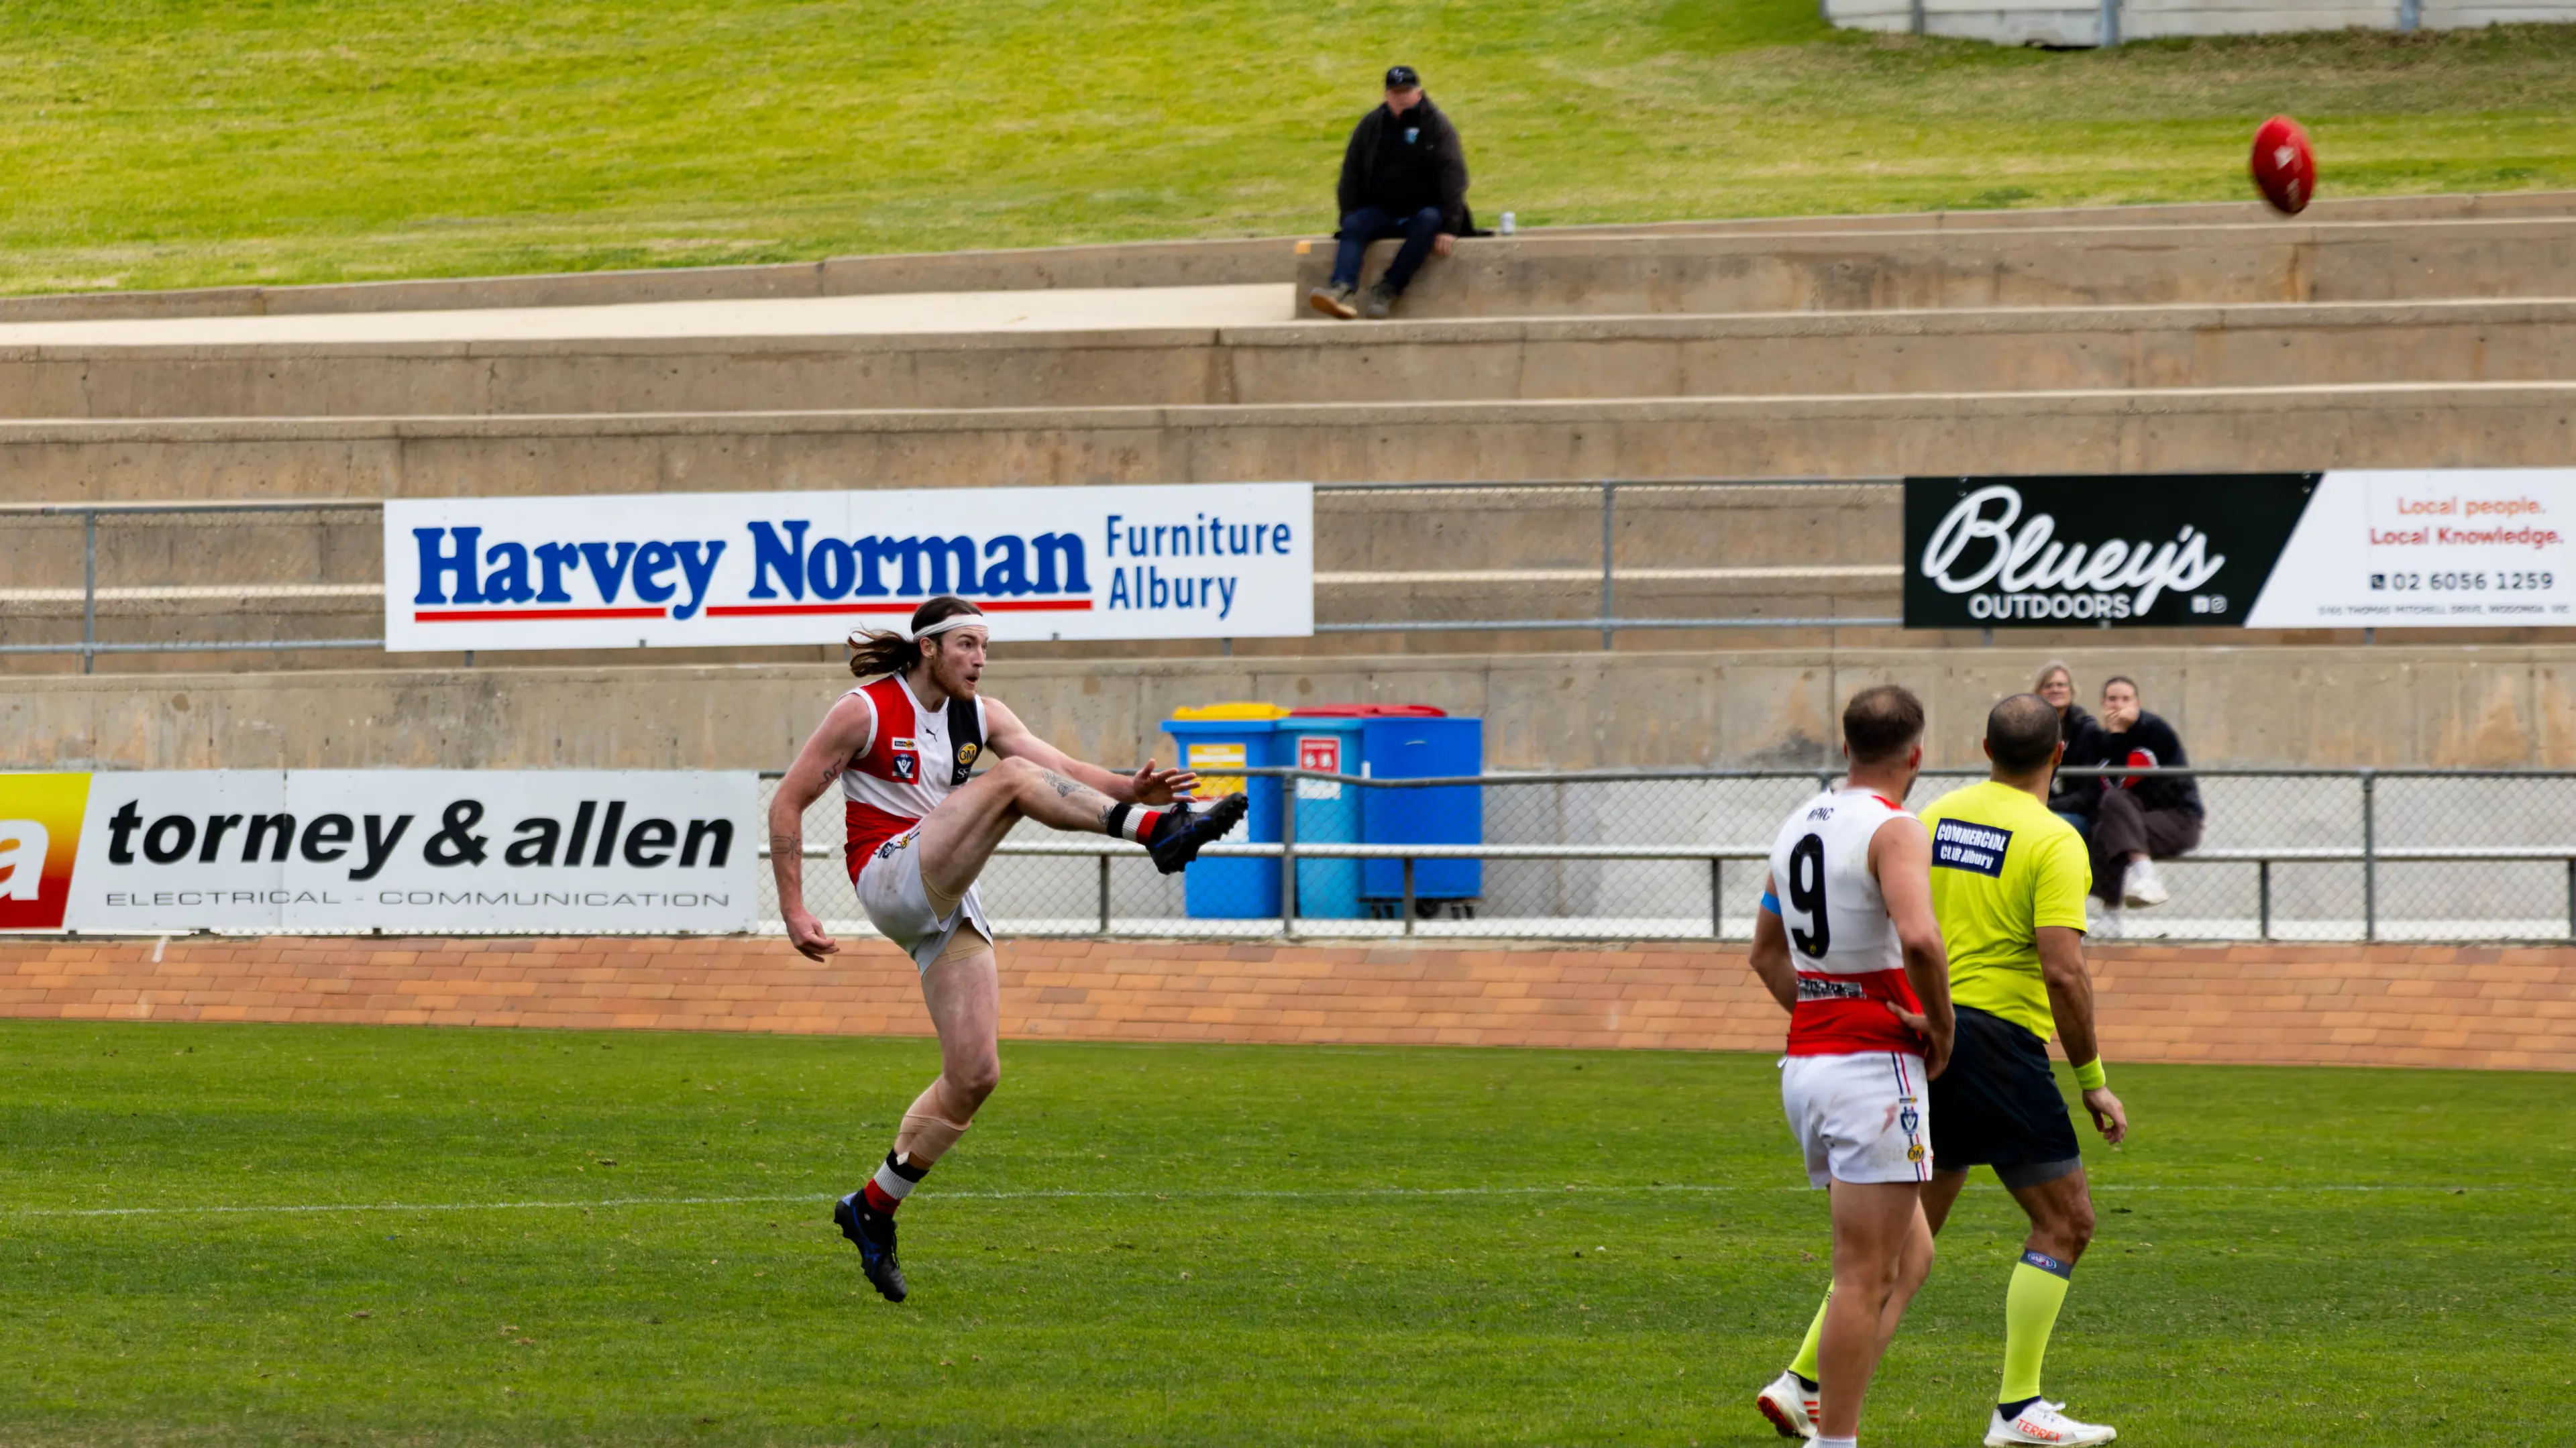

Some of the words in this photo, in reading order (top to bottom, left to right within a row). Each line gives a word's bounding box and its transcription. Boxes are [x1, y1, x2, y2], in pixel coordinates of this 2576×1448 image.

[2398, 496, 2457, 515] Local
[2465, 496, 2546, 519] people.
[1107, 513, 1292, 557] Furniture
[2370, 526, 2429, 545] Local
[2438, 526, 2564, 550] Knowledge.
[1921, 484, 2226, 616] Bluey's
[412, 526, 727, 620] Harvey
[747, 519, 1091, 601] Norman
[2393, 572, 2420, 590] 02
[2430, 572, 2487, 590] 6056
[2496, 572, 2553, 590] 1259
[1109, 565, 1238, 620] Albury
[1968, 592, 2131, 619] OUTDOORS
[109, 798, 415, 881] torney
[423, 799, 490, 867] &
[504, 800, 735, 868] allen
[1937, 824, 2007, 852] COMMERCIAL
[1960, 849, 1994, 869] Albury
[107, 891, 341, 906] ELECTRICAL
[379, 891, 729, 907] COMMUNICATION
[1789, 833, 1830, 959] 9
[2016, 1418, 2064, 1443] TERREX
